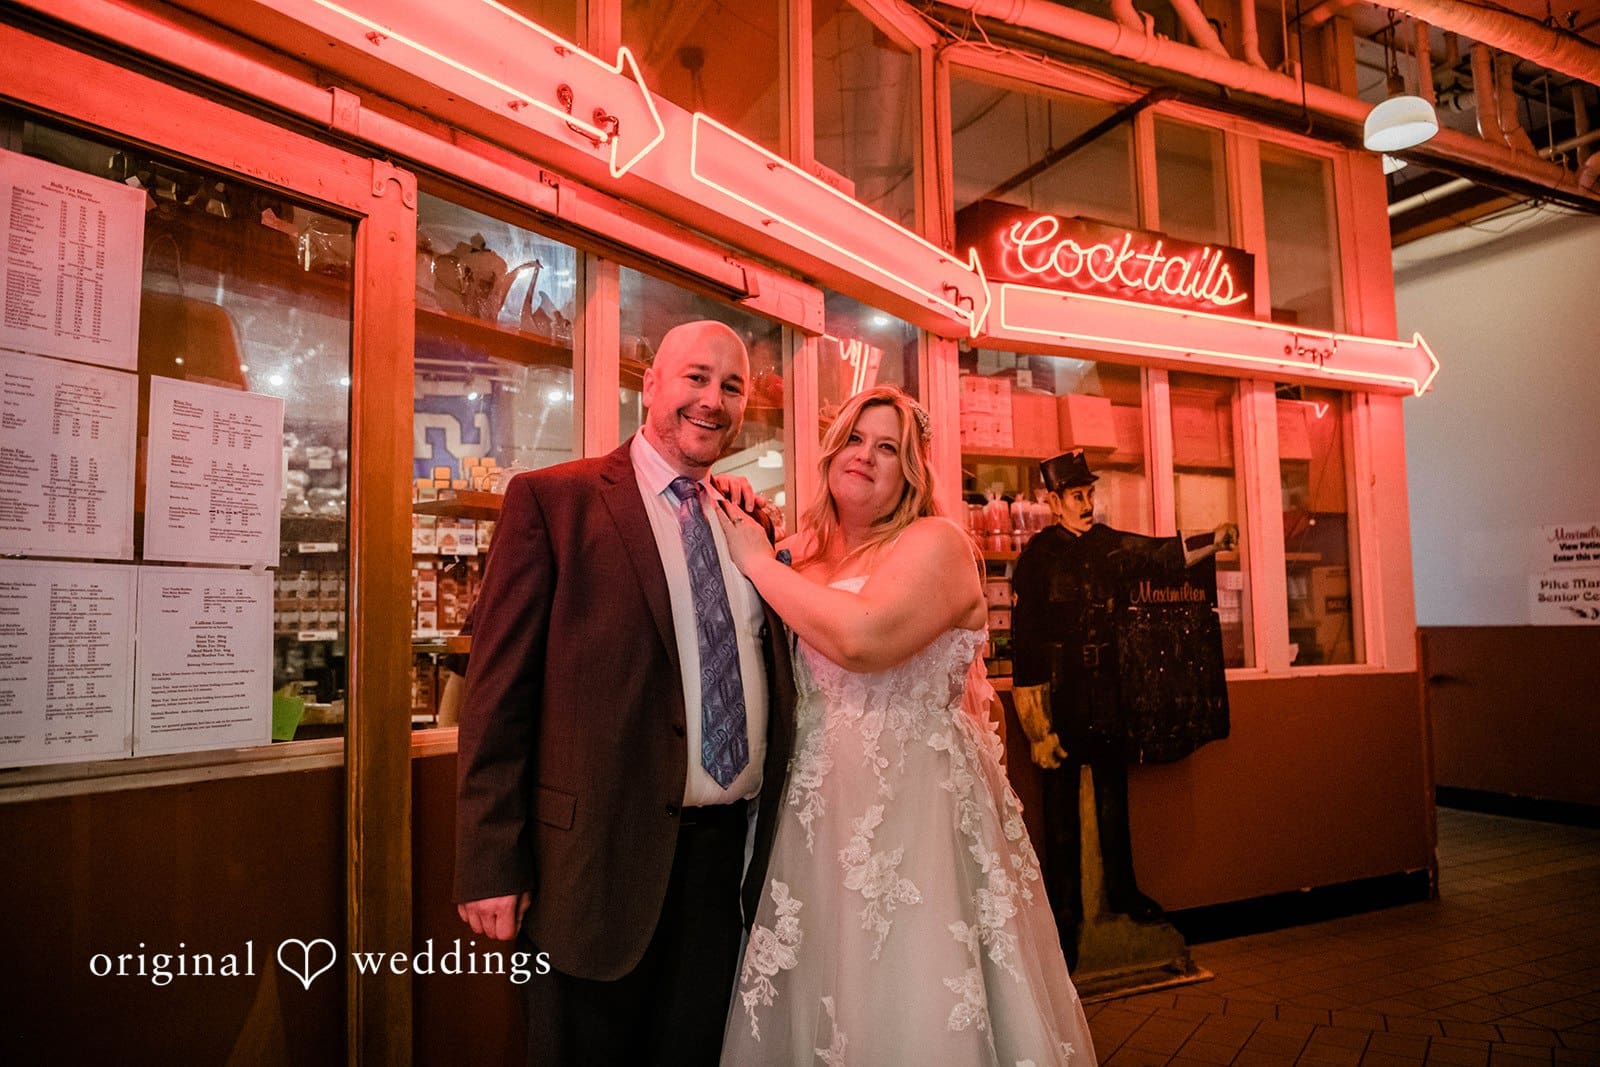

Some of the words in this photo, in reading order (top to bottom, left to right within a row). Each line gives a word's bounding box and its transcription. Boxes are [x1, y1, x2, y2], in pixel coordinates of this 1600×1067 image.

[1010, 215, 1248, 306] Cocktails
[1559, 543, 1578, 551] View
[1553, 554, 1574, 562] Enter
[1576, 552, 1591, 560] this
[1540, 579, 1569, 589] Pike
[1130, 580, 1206, 604] Maximilien
[1538, 592, 1580, 602] Senior
